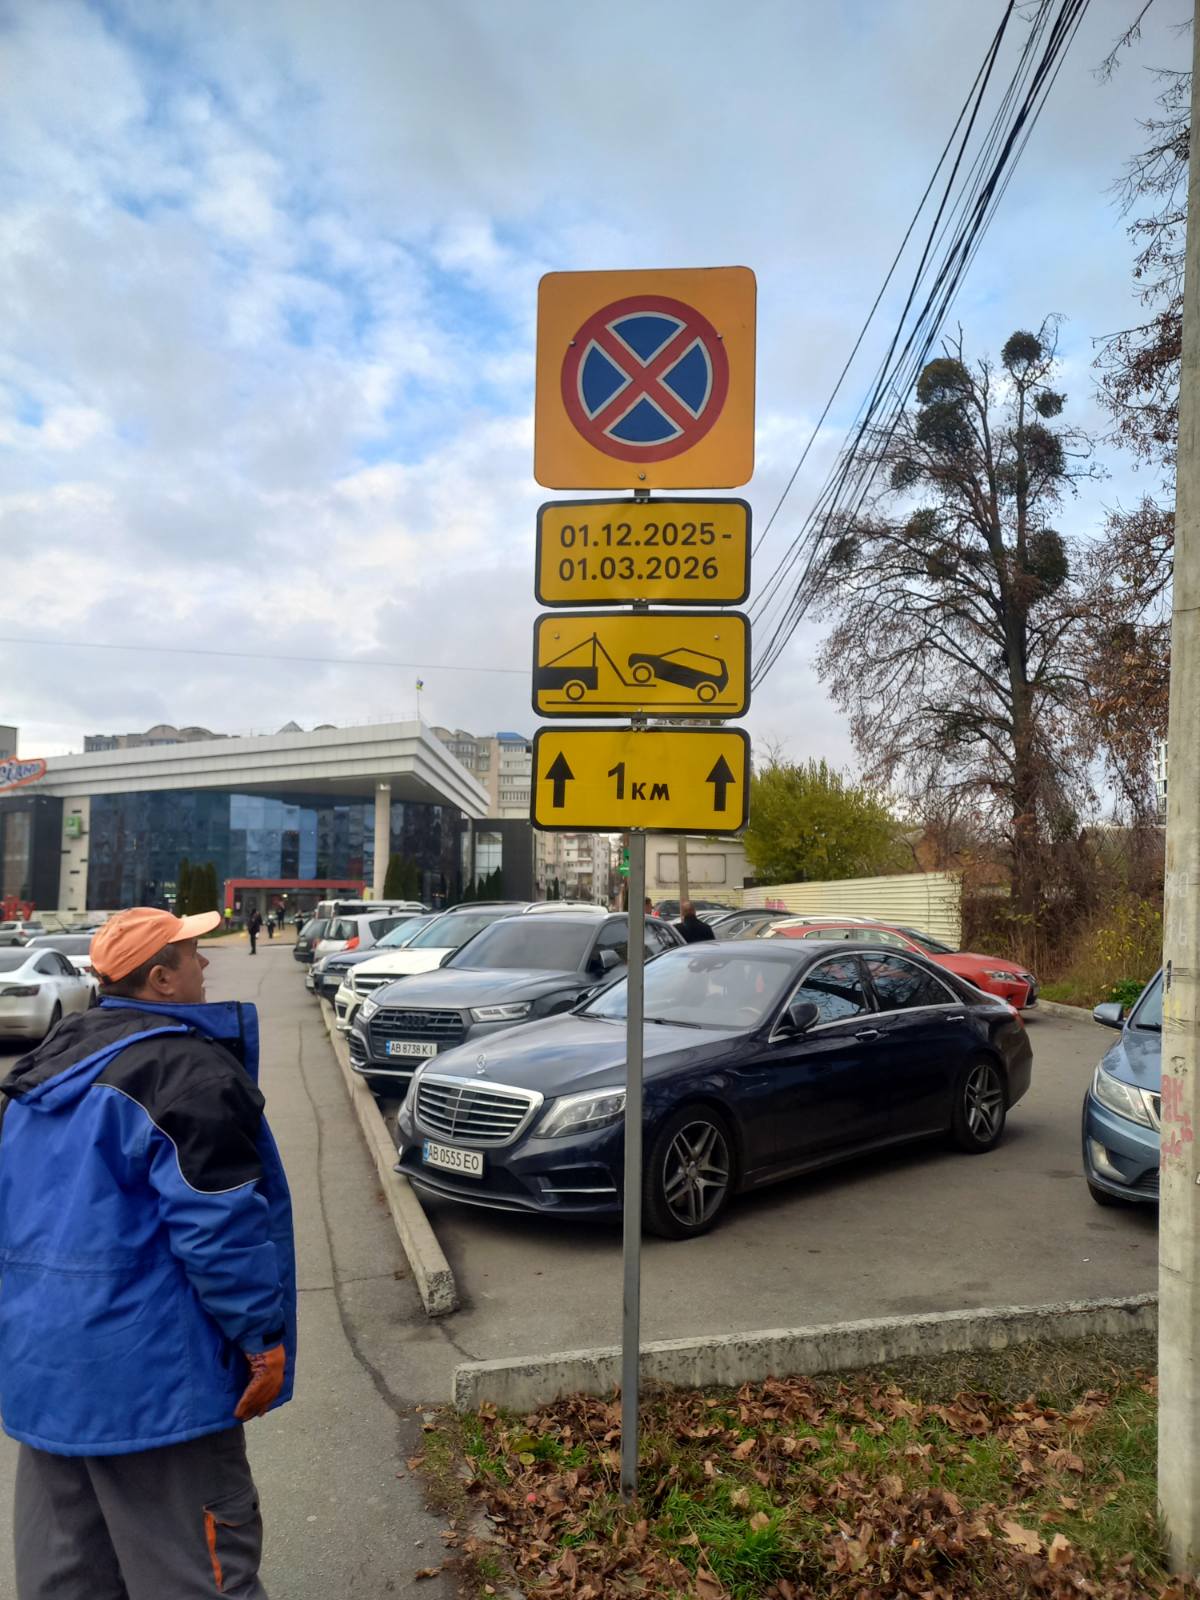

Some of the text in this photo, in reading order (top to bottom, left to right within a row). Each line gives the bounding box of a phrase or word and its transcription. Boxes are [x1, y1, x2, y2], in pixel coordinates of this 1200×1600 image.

[559, 556, 718, 581] 01.03.2026
[428, 1144, 480, 1171] AB 0555 EO
